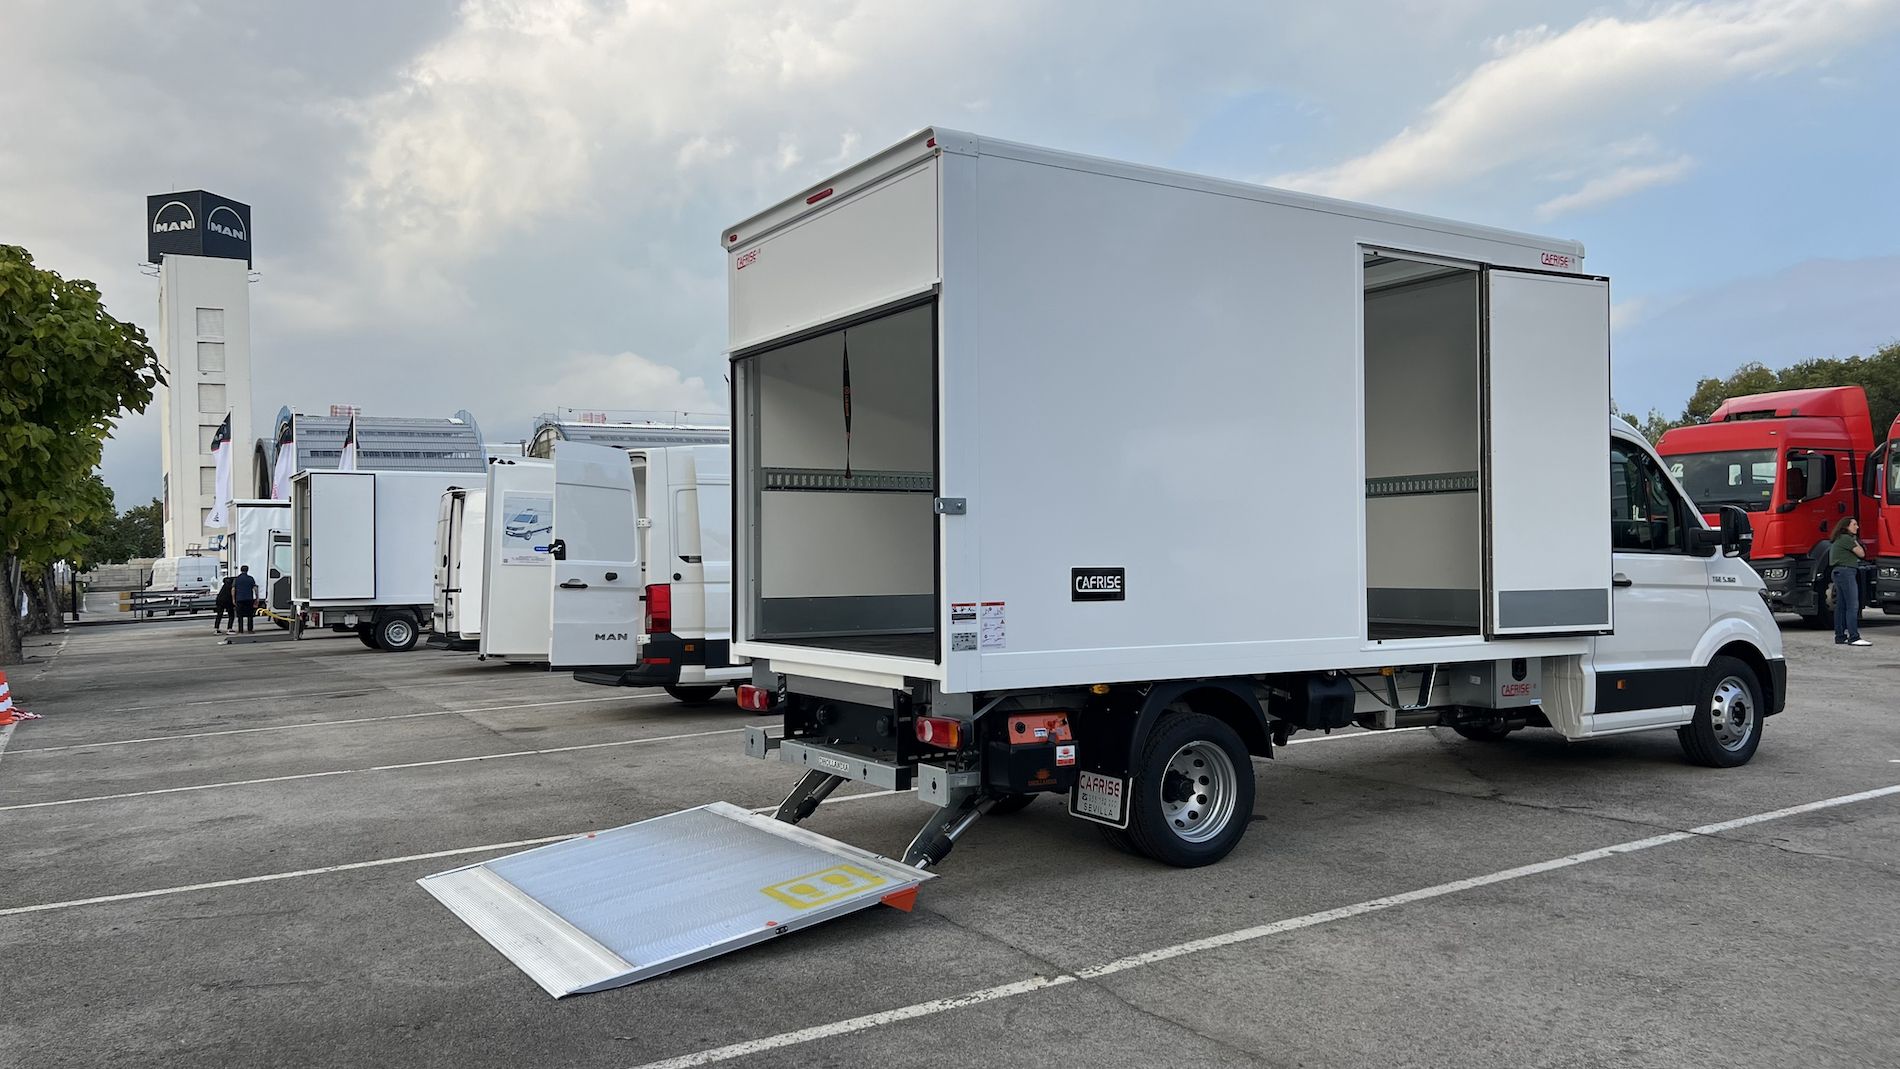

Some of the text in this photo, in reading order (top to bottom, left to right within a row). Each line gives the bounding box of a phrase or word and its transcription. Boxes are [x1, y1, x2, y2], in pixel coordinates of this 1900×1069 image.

[156, 220, 192, 233] MAN
[210, 221, 244, 241] MAN
[737, 250, 757, 270] CAFRISE
[1541, 252, 1569, 268] CAFRISE
[1075, 575, 1121, 593] CAFRISE
[595, 633, 628, 641] MAN
[1501, 683, 1530, 697] CAFRISE
[1080, 774, 1120, 798] CAFRISE
[1083, 802, 1113, 817] SEVILLA
